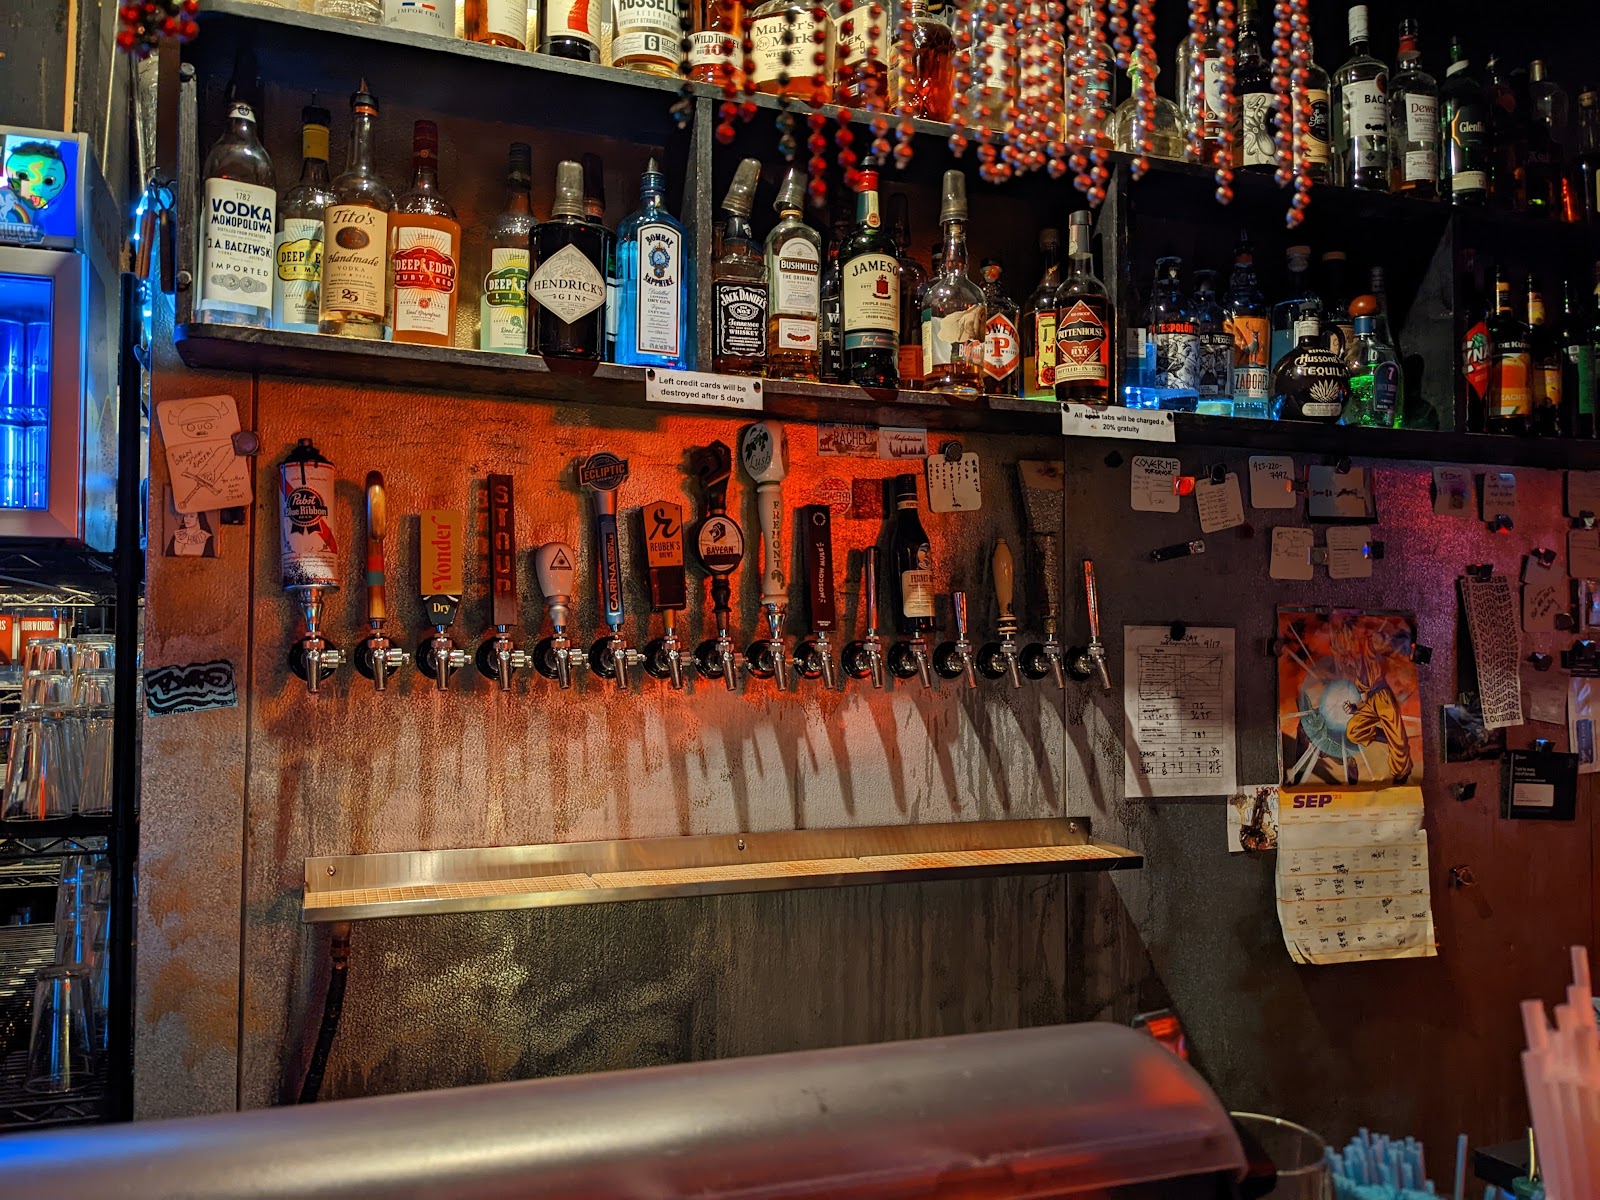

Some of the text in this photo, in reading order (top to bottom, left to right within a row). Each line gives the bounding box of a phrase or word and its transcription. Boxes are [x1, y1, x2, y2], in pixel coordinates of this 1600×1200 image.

[397, 8, 440, 19] IMPORTED
[756, 21, 815, 37] Maker's
[648, 36, 657, 50] 6
[693, 33, 740, 49] WILD TUEY
[772, 33, 813, 47] Mrk
[236, 192, 251, 201] 1782
[212, 198, 272, 223] VODKA
[211, 214, 272, 234] MONOPOLOWA
[333, 210, 375, 226] Tito's
[645, 233, 674, 248] BOMBAY
[225, 240, 273, 259] BACZEWSKI
[281, 251, 305, 263] DEEP
[328, 252, 379, 266] Handmade
[211, 262, 269, 277] IMPORTED
[396, 259, 453, 277] DEEP EDDY
[780, 260, 818, 272] BUSHMILLS
[852, 260, 898, 277] JAMESO
[435, 278, 452, 286] RED
[489, 279, 512, 290] DEEP
[643, 273, 675, 287] SAPPHIRE
[534, 279, 603, 297] HENDRICK'S
[342, 289, 359, 302] 25
[720, 289, 767, 309] JACK DANIEL'S
[1057, 327, 1103, 340] RITTENHOUSE
[991, 336, 1011, 357] P
[1302, 366, 1347, 377] TEQUILA
[659, 377, 674, 385] Left
[676, 379, 698, 387] credit
[700, 381, 721, 390] cards
[723, 383, 736, 391] will
[661, 388, 744, 404] destroyed after 5 days
[1136, 417, 1160, 426] charged
[1117, 425, 1140, 433] gratuity
[584, 463, 625, 481] ECLIPTIC
[292, 492, 317, 506] Pabst
[300, 505, 327, 516] Ribbon
[771, 500, 782, 569] FREMONT
[431, 515, 451, 591] Yonder
[650, 541, 681, 552] REUBEN'S
[608, 563, 619, 611] CARINA
[818, 567, 826, 600] MOSCOW
[1472, 584, 1509, 593] OUTSIDERS
[1473, 590, 1511, 604] OUTSIDERS
[433, 602, 450, 613] Dry
[1487, 691, 1518, 706] OUTSIDERS
[1488, 701, 1519, 714] OUTSIDERS
[1490, 711, 1520, 722] OUTSIDERS
[1293, 795, 1332, 808] SEP
